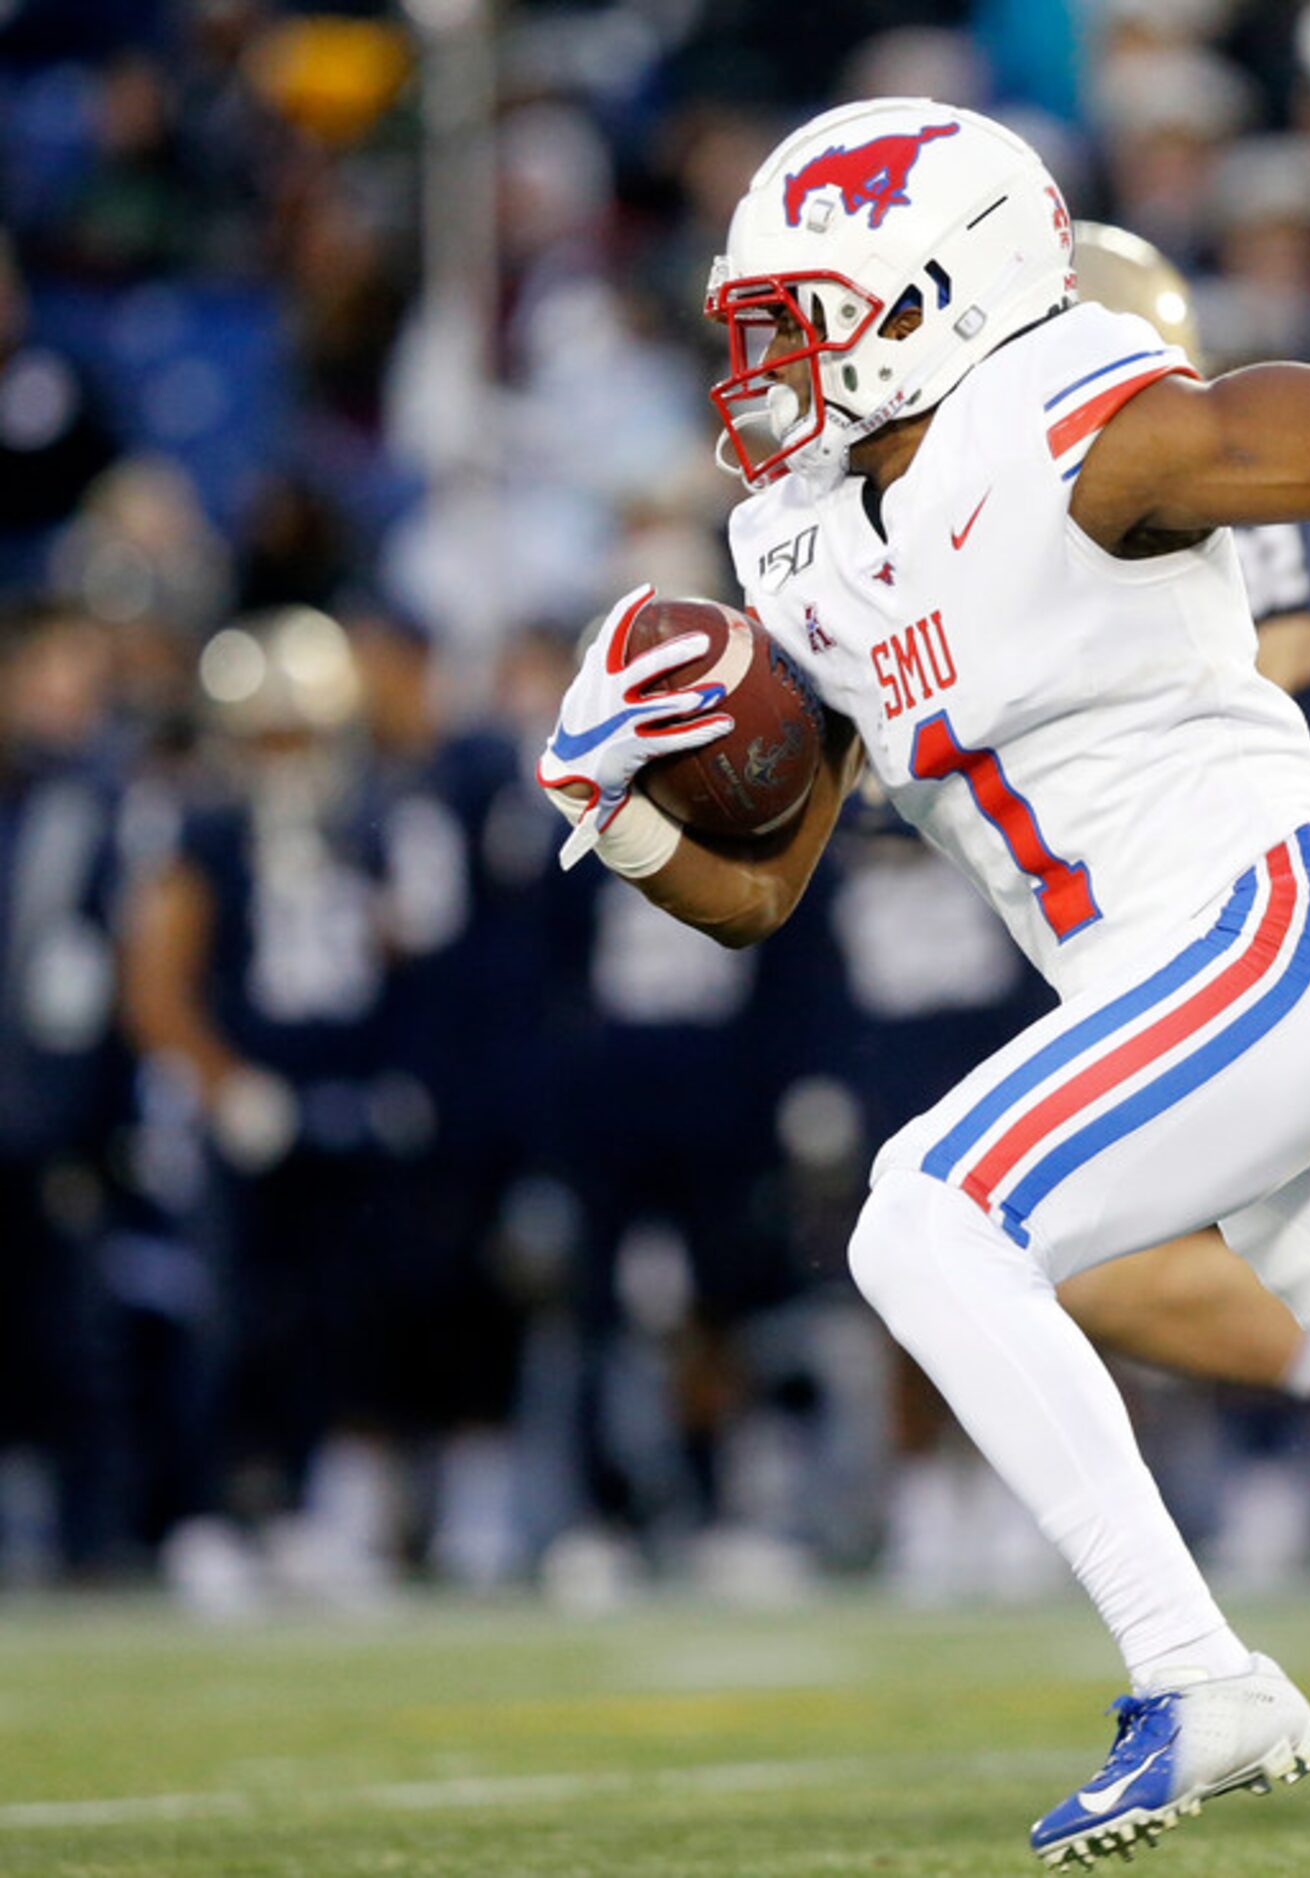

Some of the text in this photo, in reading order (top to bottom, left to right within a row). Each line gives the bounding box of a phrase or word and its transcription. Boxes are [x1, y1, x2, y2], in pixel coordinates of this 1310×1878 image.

[759, 524, 819, 592] 150
[870, 609, 958, 720] SMU
[908, 708, 1104, 946] 1
